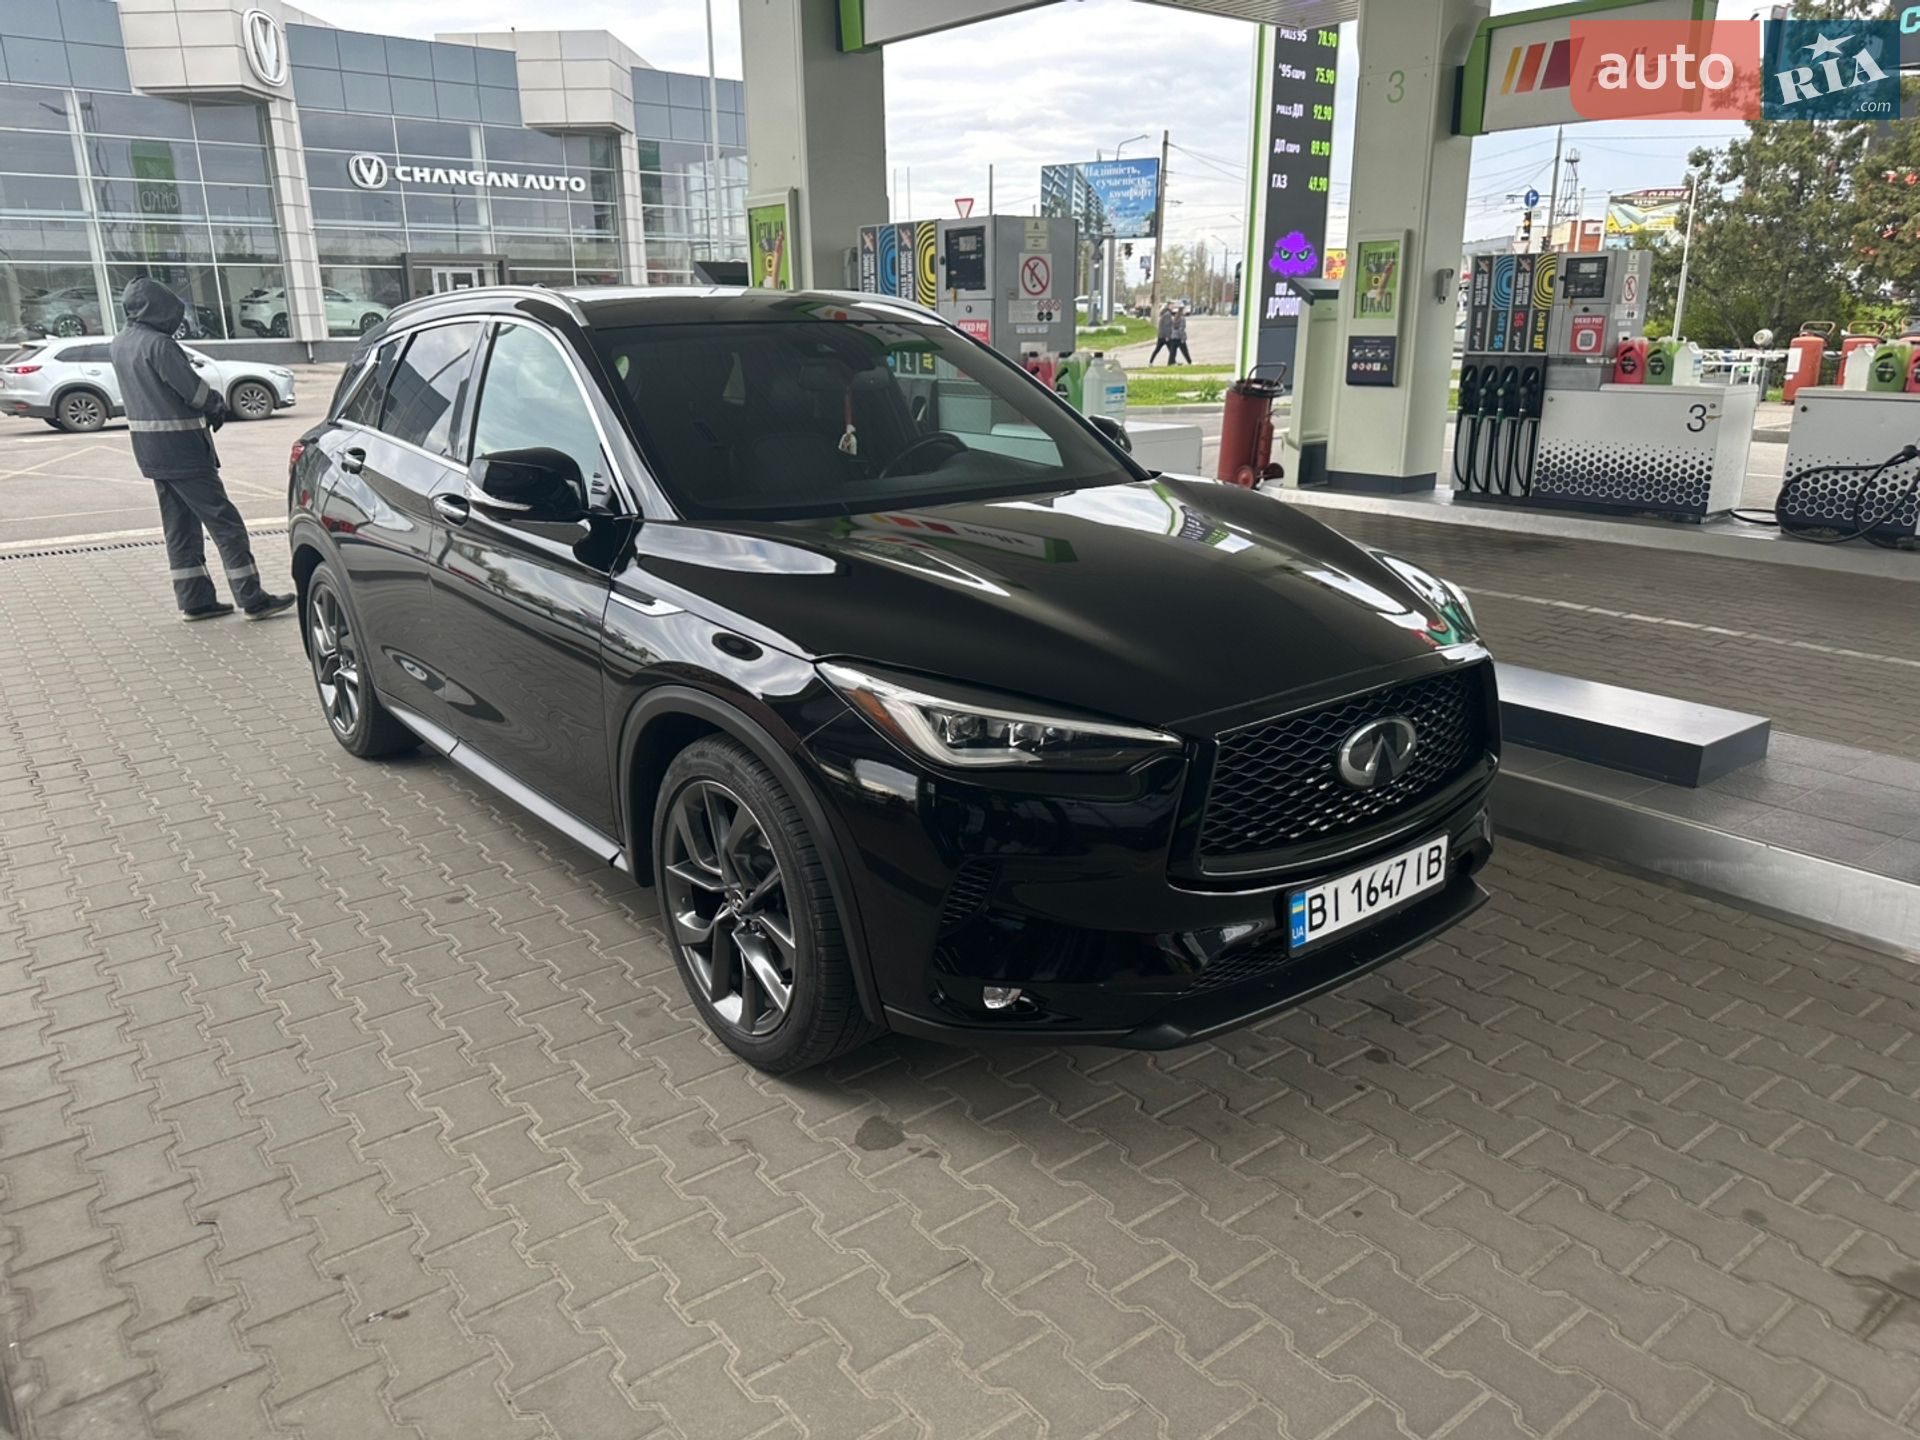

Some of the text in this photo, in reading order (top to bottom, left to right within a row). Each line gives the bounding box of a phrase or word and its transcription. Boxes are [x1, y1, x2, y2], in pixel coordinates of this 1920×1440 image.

[1315, 67, 1335, 85] 75.90
[1387, 70, 1405, 104] 3
[1313, 104, 1333, 121] 92.90
[394, 165, 587, 192] CHANGAN AUTO
[1271, 173, 1288, 189] ГАЗ
[1513, 312, 1525, 328] 95
[1687, 404, 1707, 432] 3
[1308, 844, 1443, 933] BI 1647 IB
[1291, 925, 1304, 940] UA
